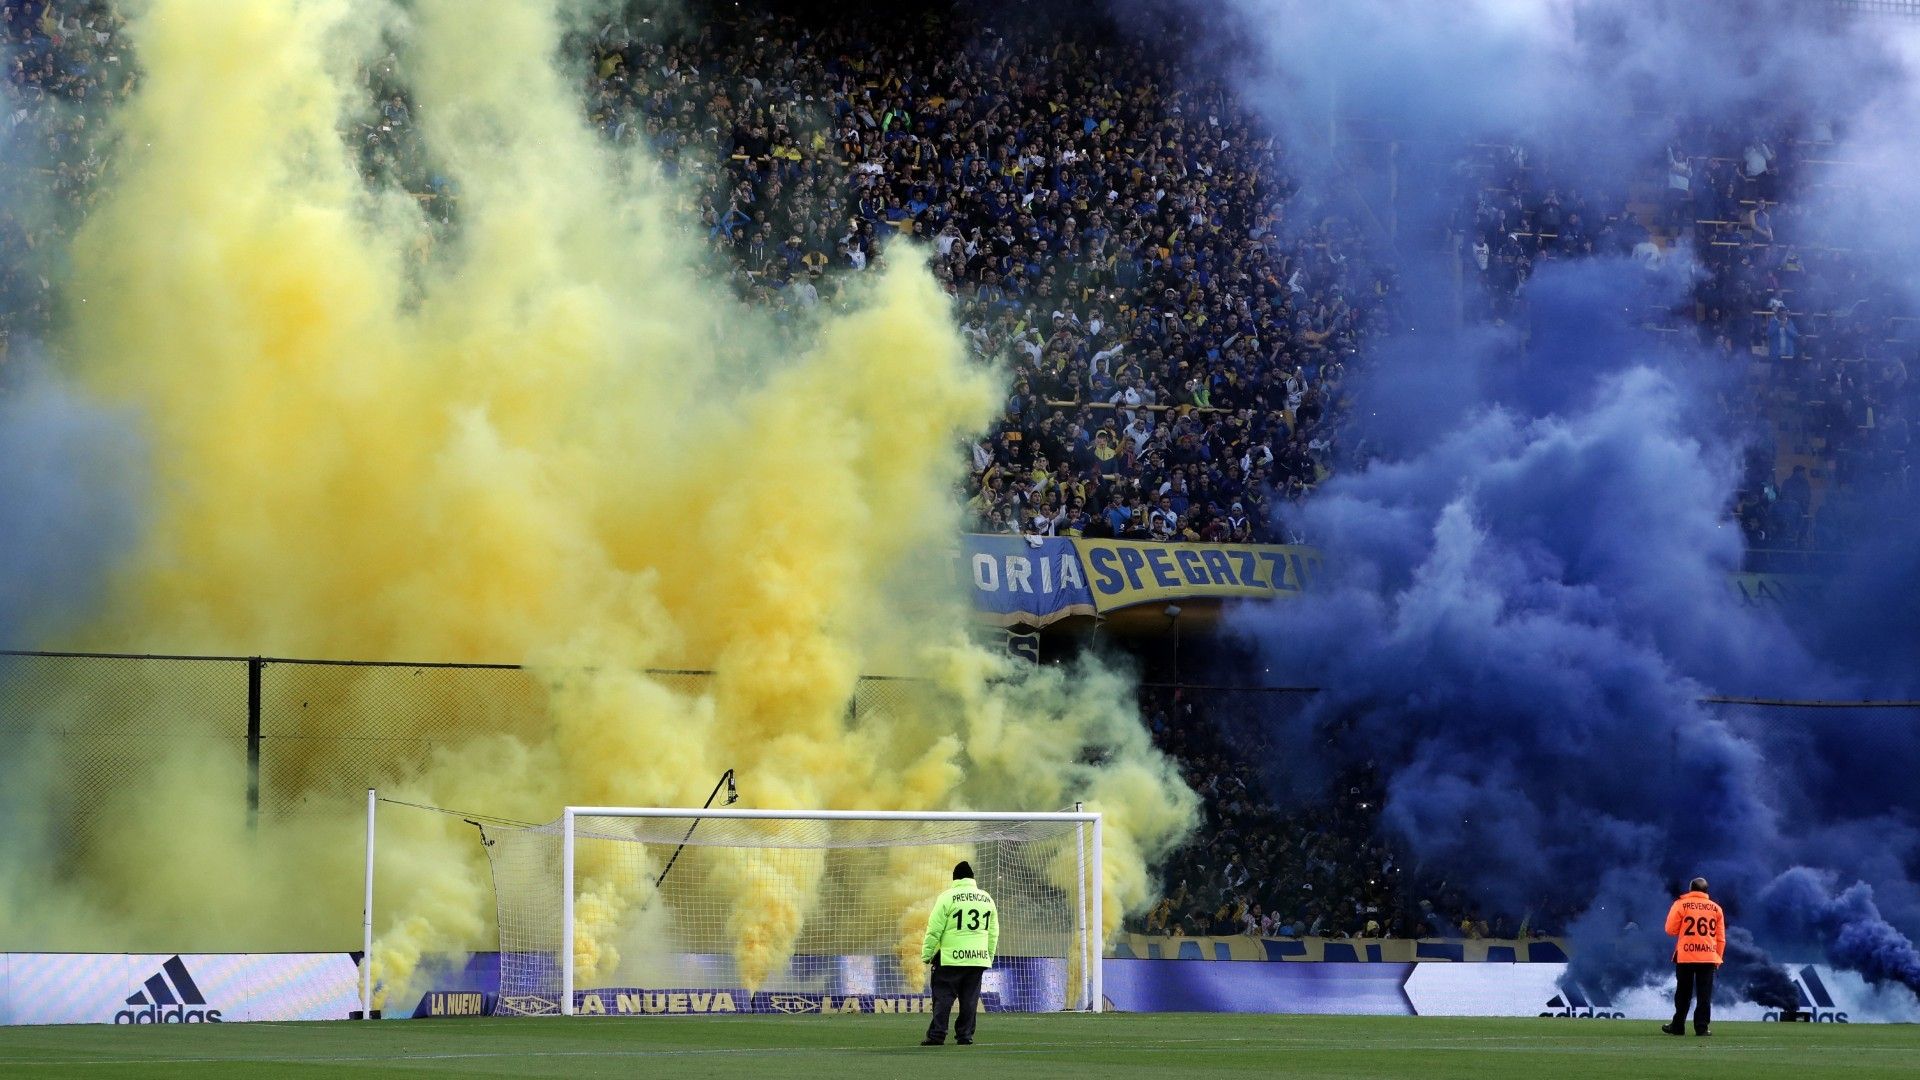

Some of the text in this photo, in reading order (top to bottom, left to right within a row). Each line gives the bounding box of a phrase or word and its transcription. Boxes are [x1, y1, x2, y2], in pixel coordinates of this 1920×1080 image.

[952, 908, 991, 931] 131
[1683, 916, 1717, 937] 269
[952, 949, 988, 960] COMAHUE
[114, 1003, 222, 1024] adidas
[431, 993, 481, 1015] LA NUEVA
[616, 993, 736, 1013] NUEVA
[822, 996, 860, 1013] LA
